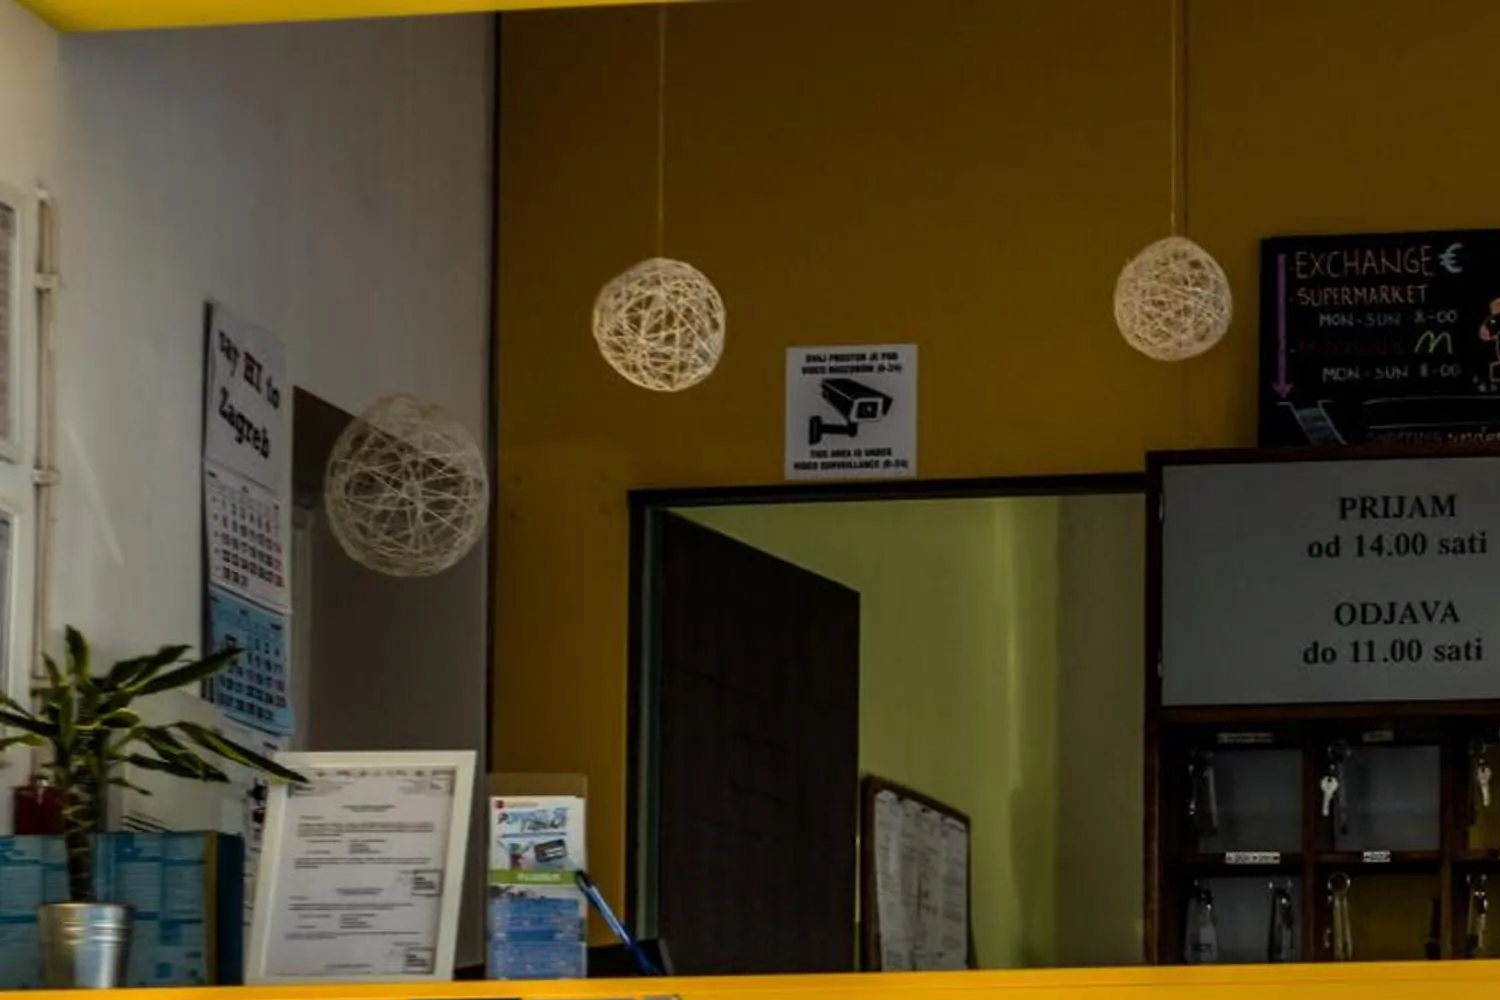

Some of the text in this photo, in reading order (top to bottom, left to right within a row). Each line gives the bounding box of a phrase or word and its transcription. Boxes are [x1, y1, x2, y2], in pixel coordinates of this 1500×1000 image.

[1295, 245, 1436, 279] EXCHANGE
[1296, 284, 1429, 306] SUPERMARKET
[218, 386, 269, 459] Zagreb
[1338, 494, 1458, 520] PRIJAM
[1307, 531, 1487, 558] od 14.00 sati
[1334, 600, 1460, 626] ODJAVA
[1303, 638, 1483, 664] do 11.00 sati
